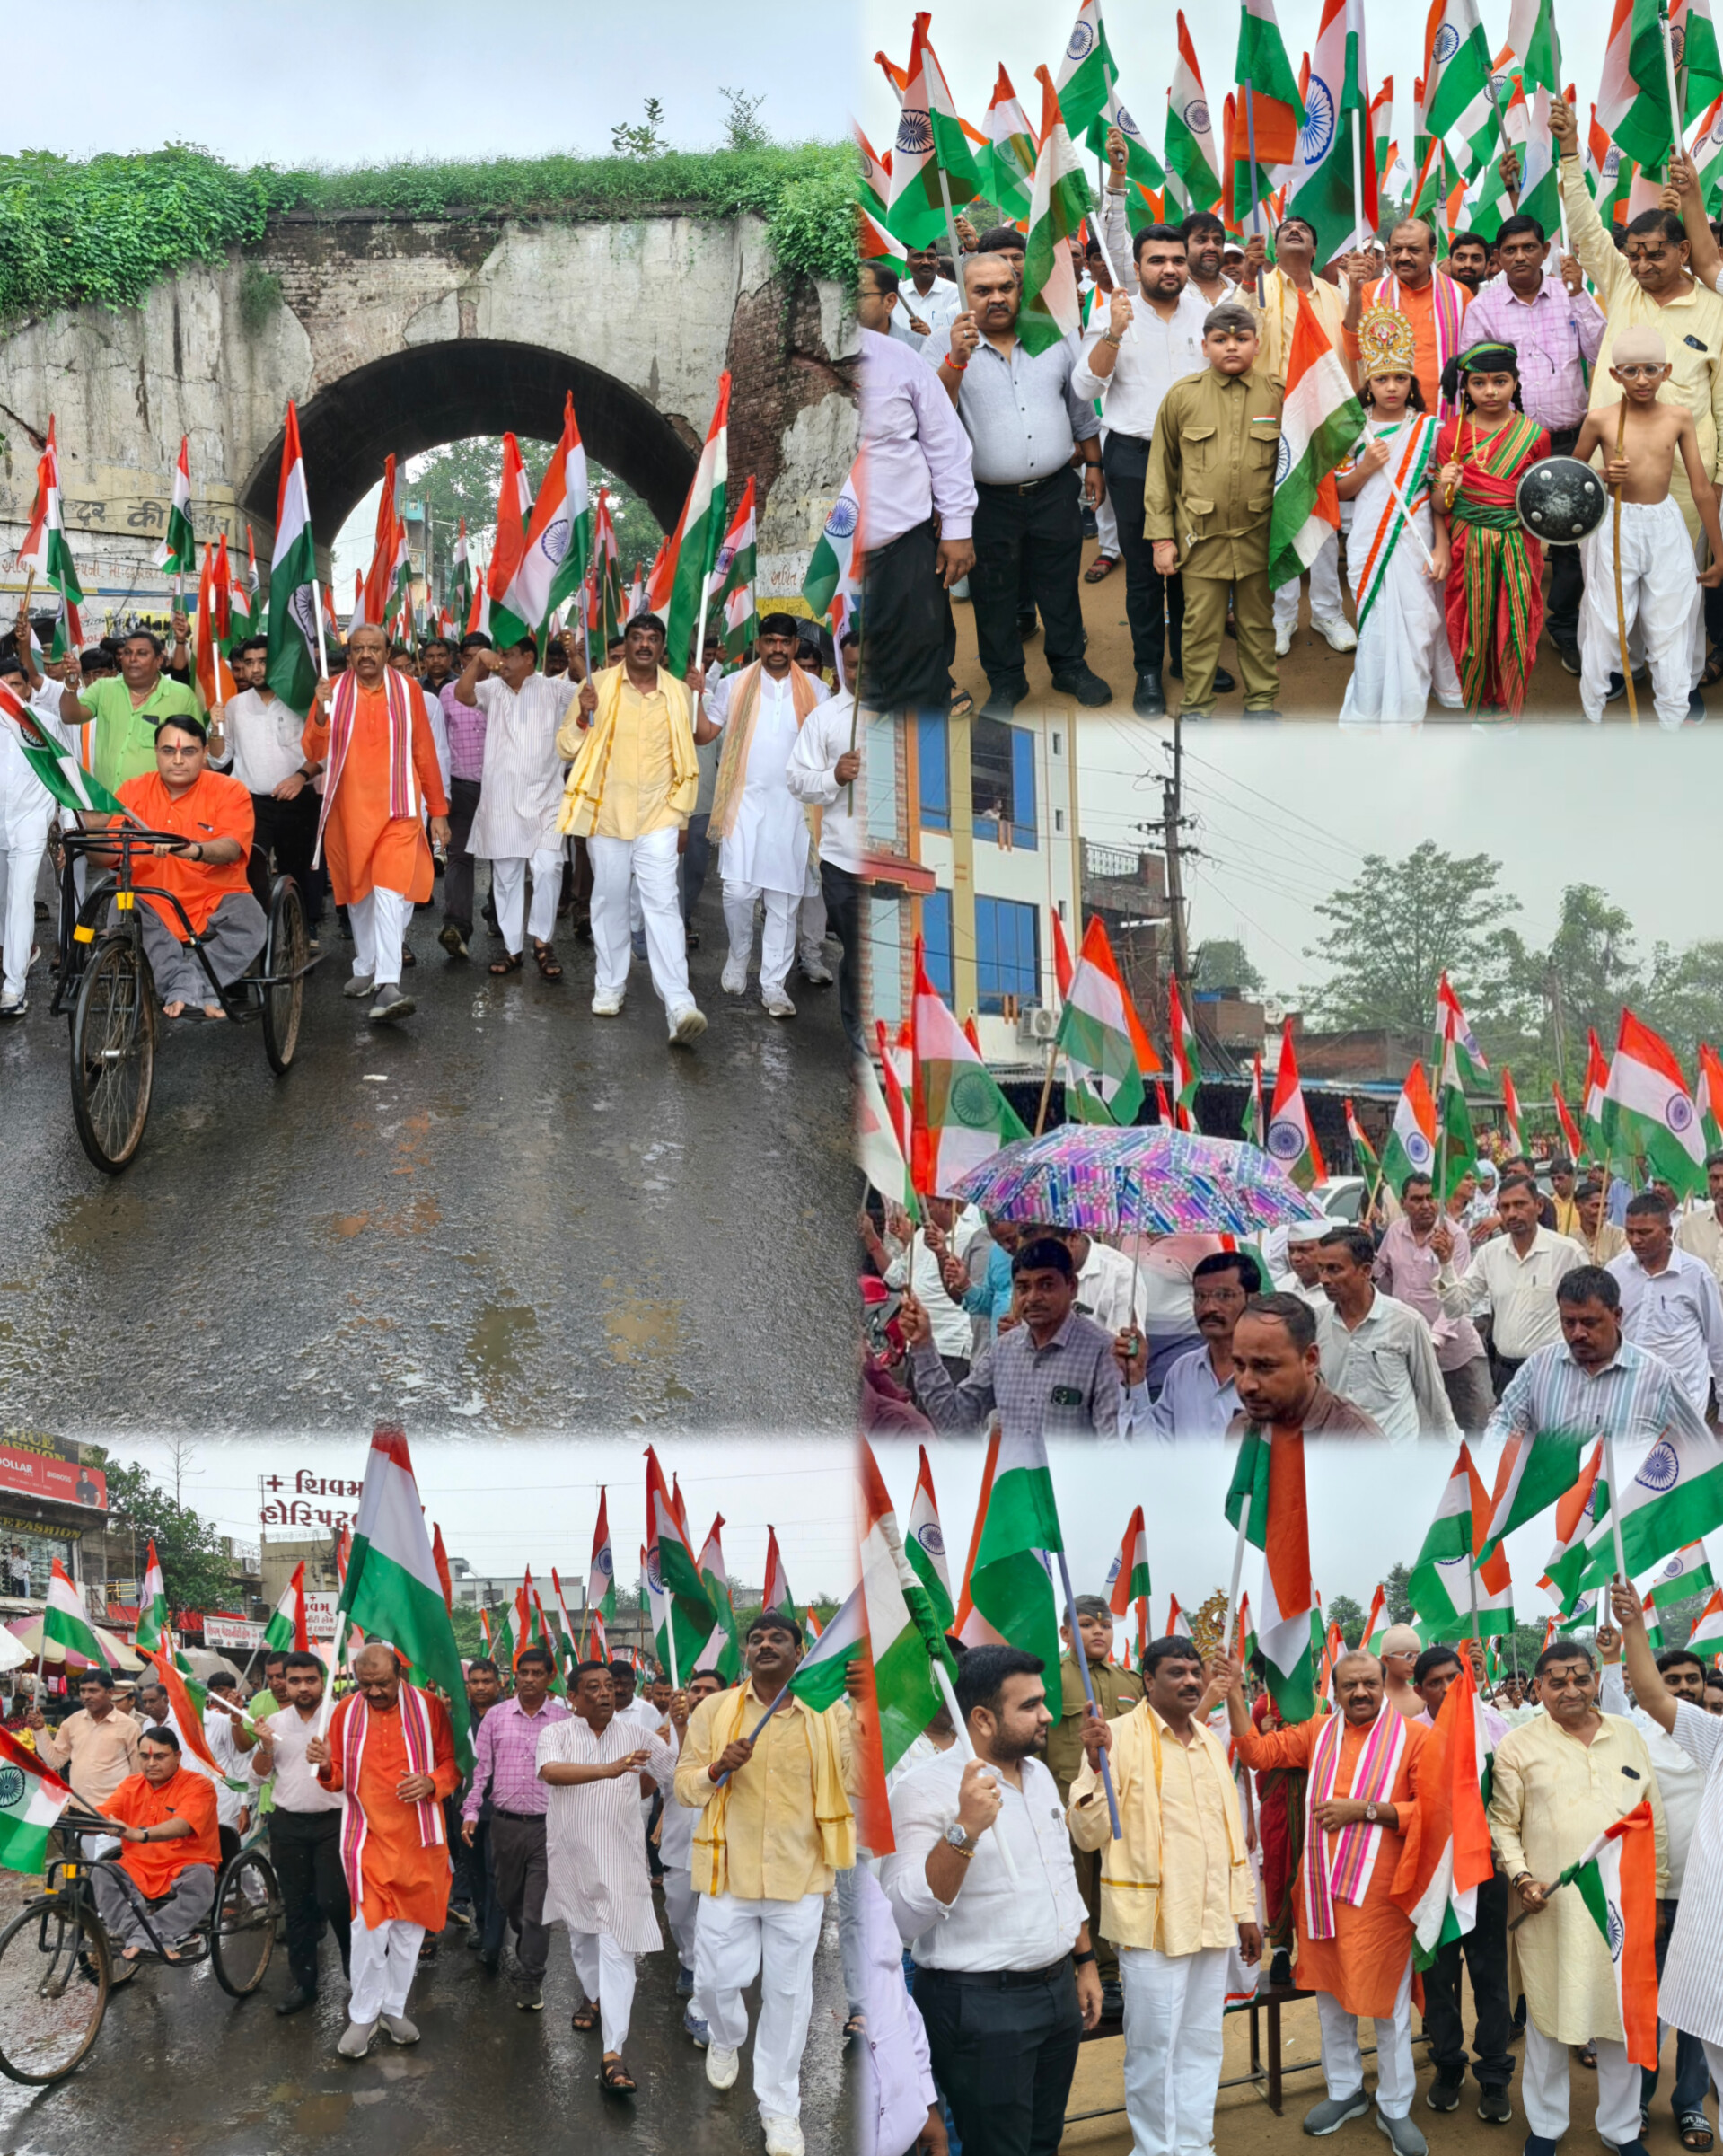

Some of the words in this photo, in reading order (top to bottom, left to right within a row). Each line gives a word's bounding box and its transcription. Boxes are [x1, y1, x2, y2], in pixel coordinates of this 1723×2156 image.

[127, 500, 165, 529] की
[0, 1457, 33, 1474] OLLAR
[260, 1499, 359, 1528] હોસ્પિટ
[14, 1518, 82, 1539] FASHION
[305, 1602, 333, 1616] વમ્
